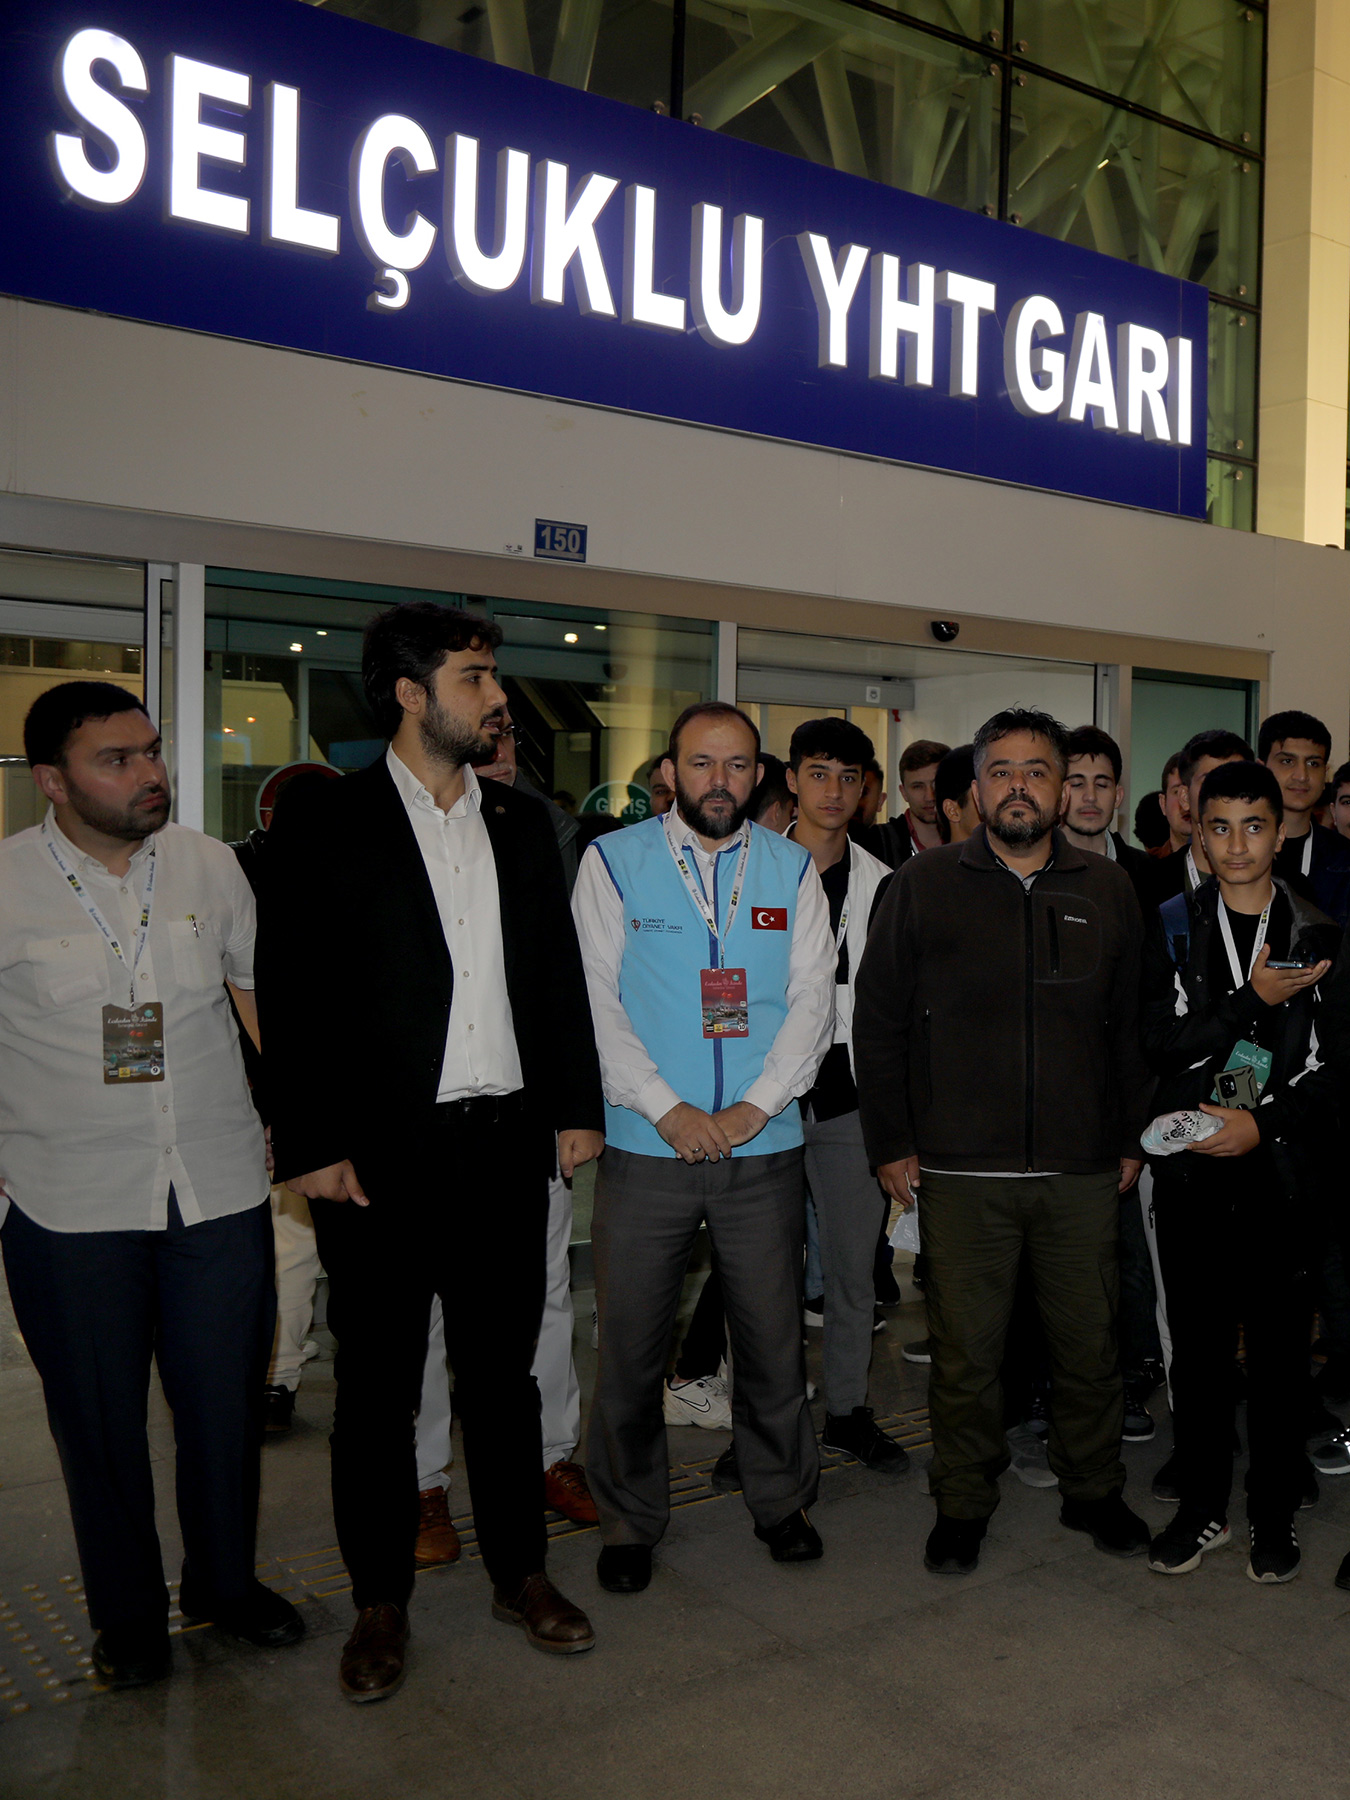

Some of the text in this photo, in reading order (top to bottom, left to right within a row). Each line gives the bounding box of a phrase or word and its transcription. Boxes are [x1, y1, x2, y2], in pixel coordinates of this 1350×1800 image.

[52, 28, 1192, 448] SELÇUKLU YHT GARI
[540, 526, 581, 553] 150
